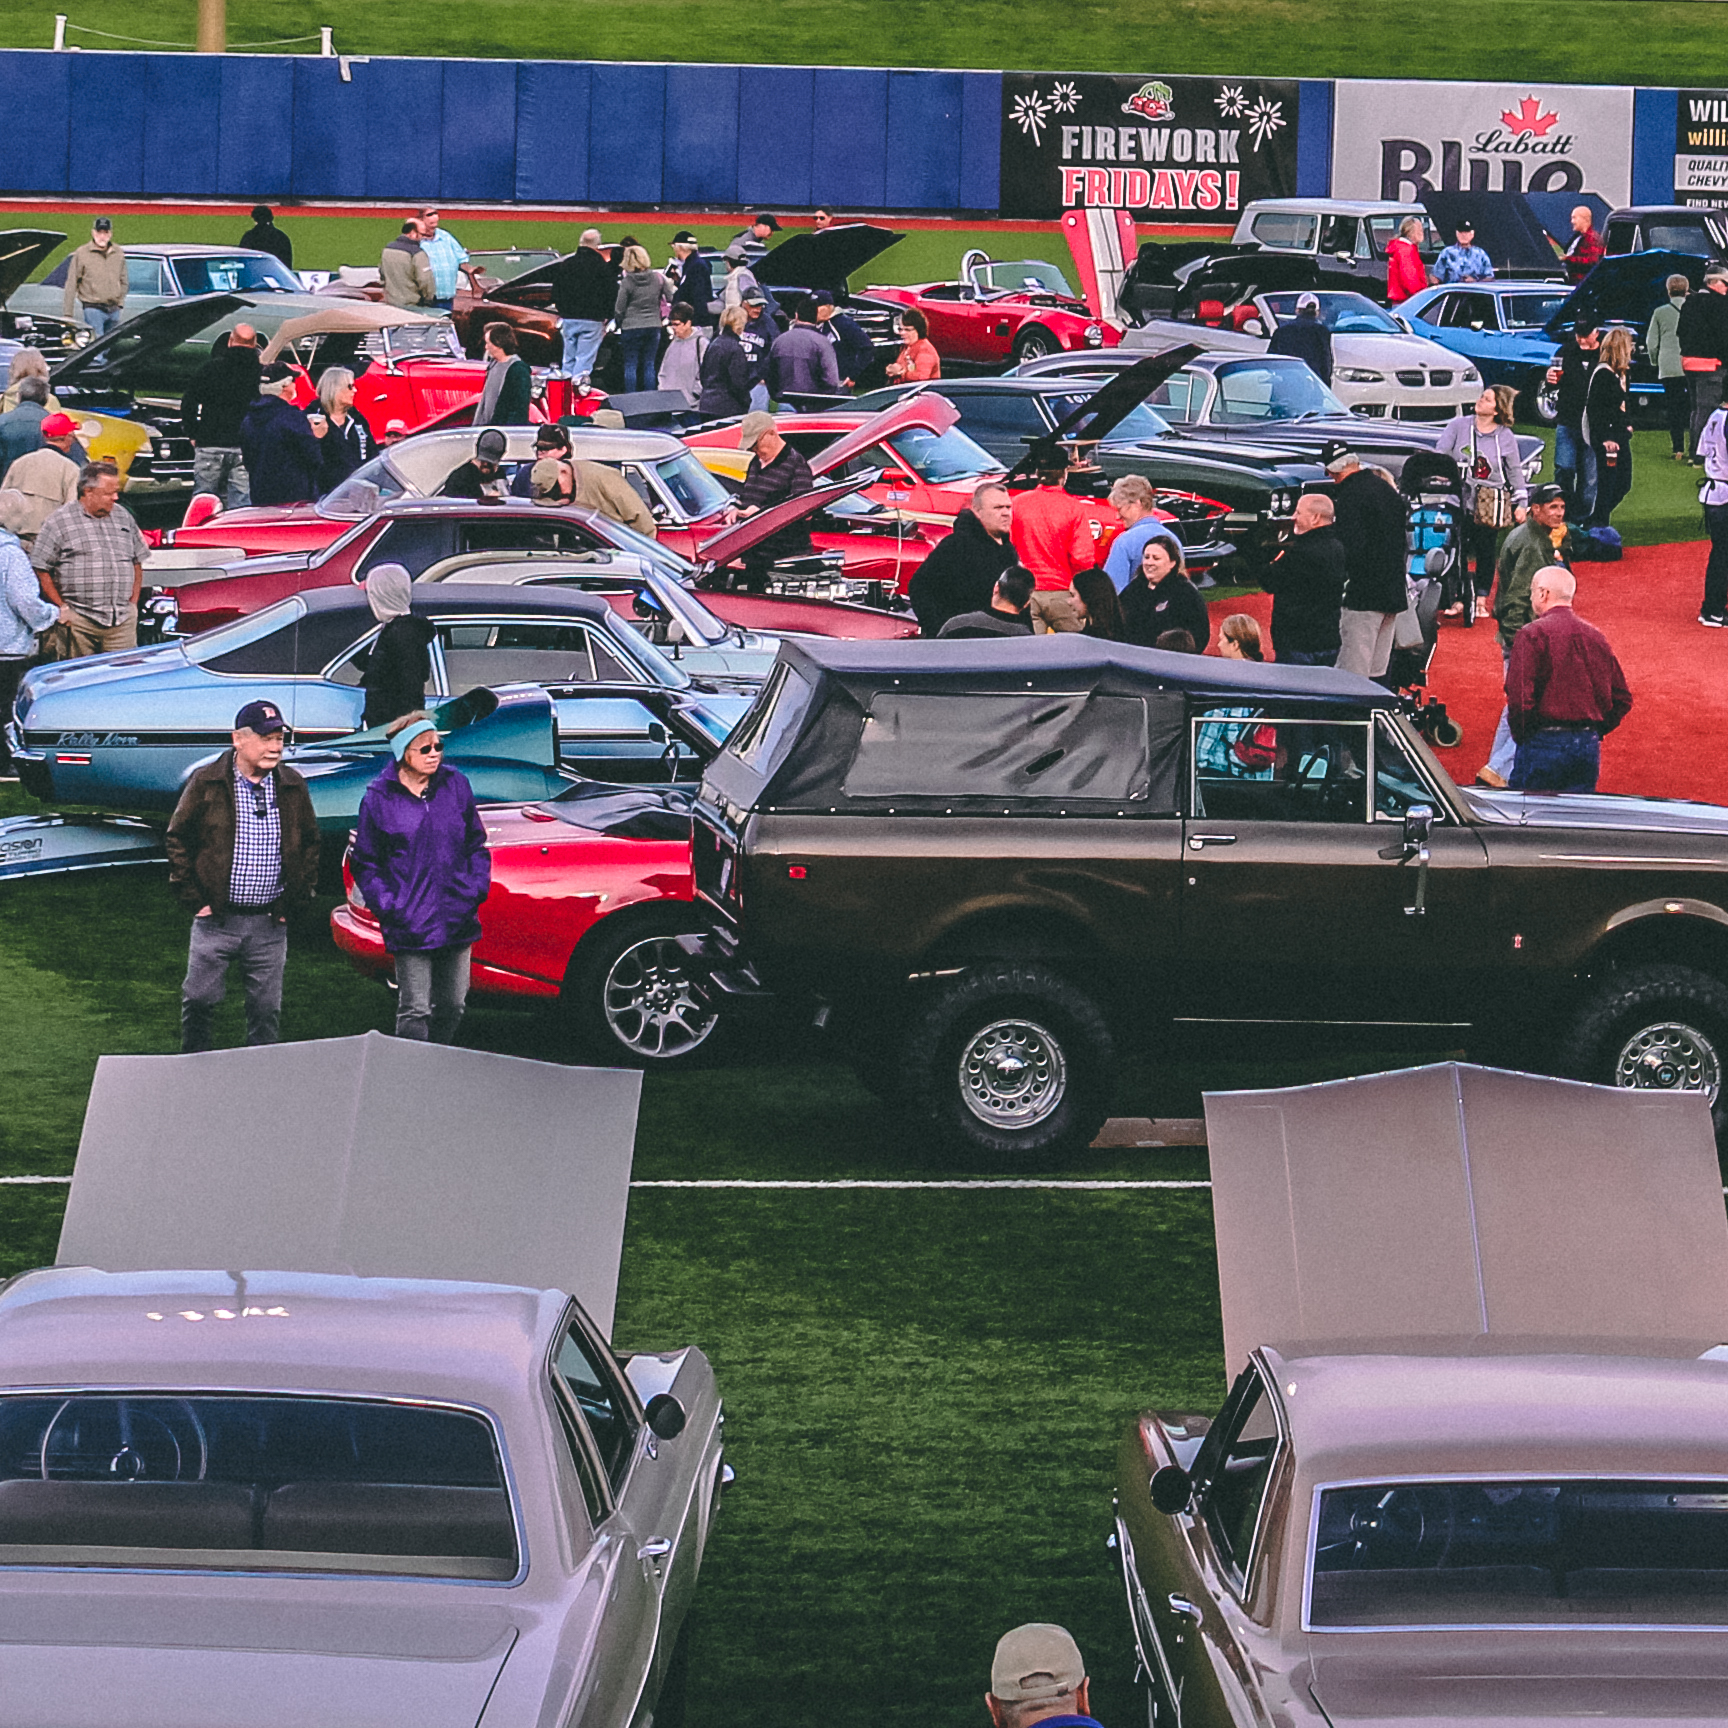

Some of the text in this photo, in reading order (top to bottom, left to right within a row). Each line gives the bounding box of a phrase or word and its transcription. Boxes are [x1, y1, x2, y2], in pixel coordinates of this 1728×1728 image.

[1060, 125, 1242, 164] FIREWORK
[1468, 129, 1574, 155] Labatt
[1057, 166, 1242, 211] FRIDAYS!
[1686, 175, 1728, 188] CHEVY
[1686, 198, 1710, 210] FIND
